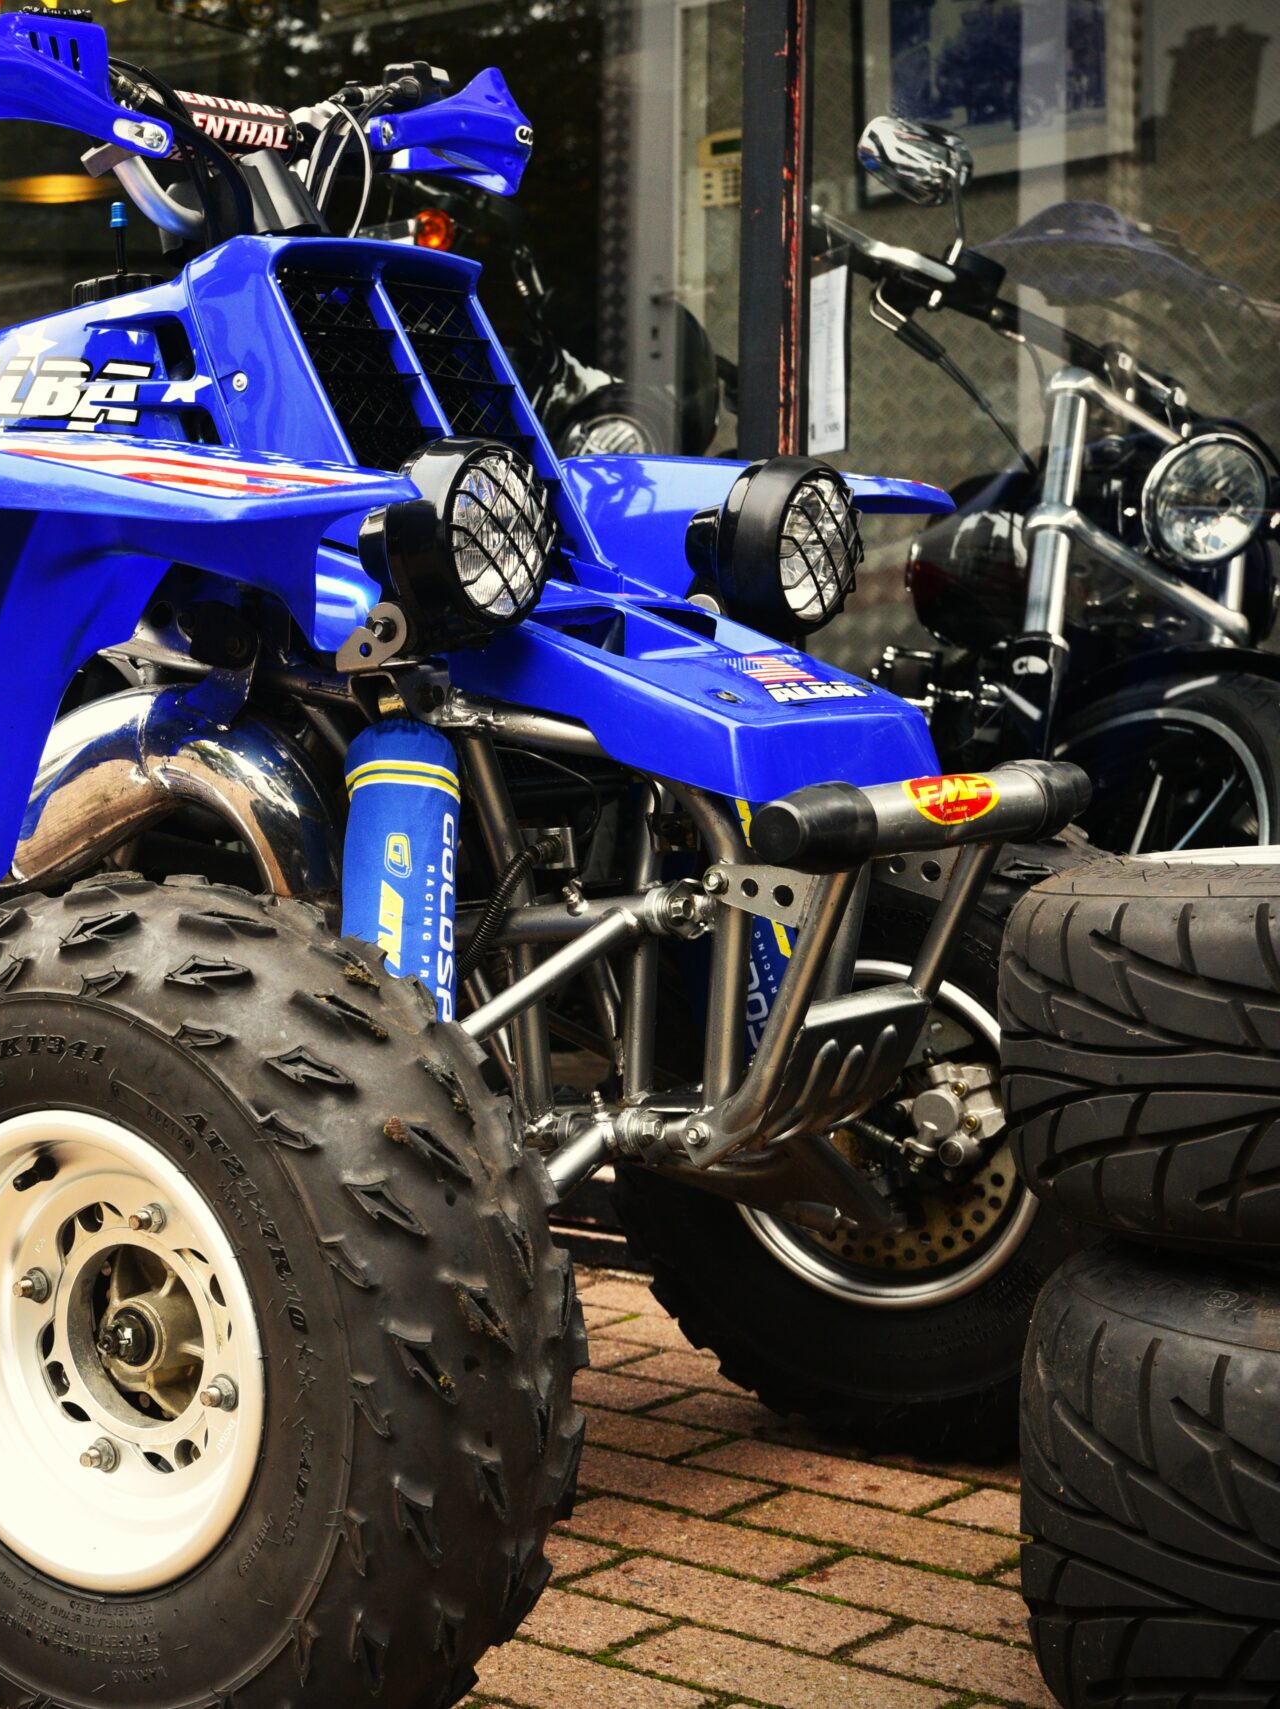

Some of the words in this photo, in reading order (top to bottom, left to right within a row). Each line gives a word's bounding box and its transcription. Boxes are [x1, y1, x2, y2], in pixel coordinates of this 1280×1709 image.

[191, 110, 289, 150] ENTHAL
[762, 681, 871, 704] ALBA
[918, 777, 987, 808] FMF
[421, 864, 436, 941] RACING
[436, 812, 456, 1023] GOLDSP
[755, 931, 778, 994] RACING
[0, 1034, 107, 1065] KT341
